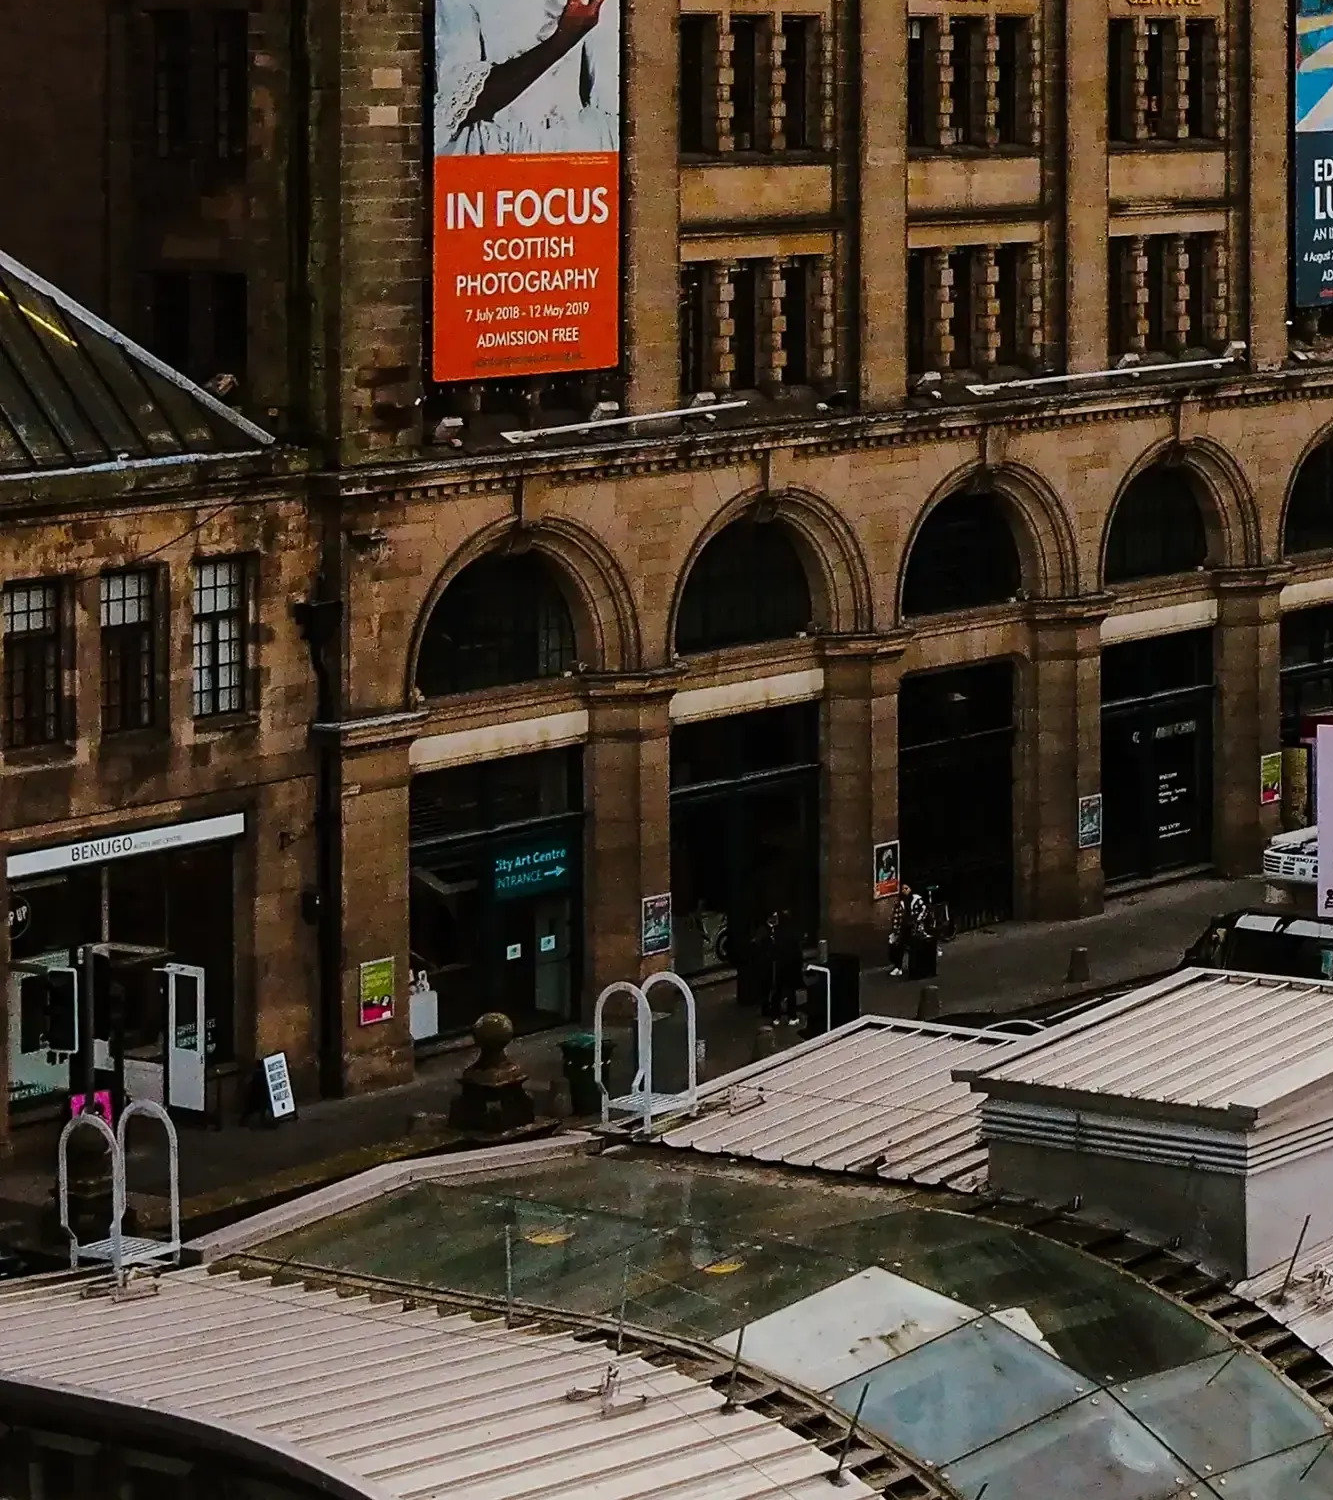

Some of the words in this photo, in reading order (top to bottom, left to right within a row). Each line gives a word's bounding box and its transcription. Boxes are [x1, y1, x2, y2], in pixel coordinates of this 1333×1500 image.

[446, 191, 484, 230] IN
[495, 185, 610, 228] FOCUS
[1313, 227, 1328, 242] AN
[483, 235, 575, 261] SCOTTISH
[1308, 251, 1331, 264] August
[456, 267, 600, 297] PHOTOGRAPHY
[465, 309, 473, 323] 7
[474, 307, 495, 324] July
[495, 305, 520, 320] 2018
[529, 304, 541, 318] 12
[543, 302, 565, 319] May
[565, 301, 590, 316] 2019
[476, 329, 549, 349] ADMISSION
[551, 326, 580, 343] FREE
[71, 836, 133, 862] BENUGO
[514, 854, 531, 868] Art
[533, 848, 567, 863] Centre
[496, 869, 543, 889] NTRANCE
[1325, 889, 1333, 910] The
